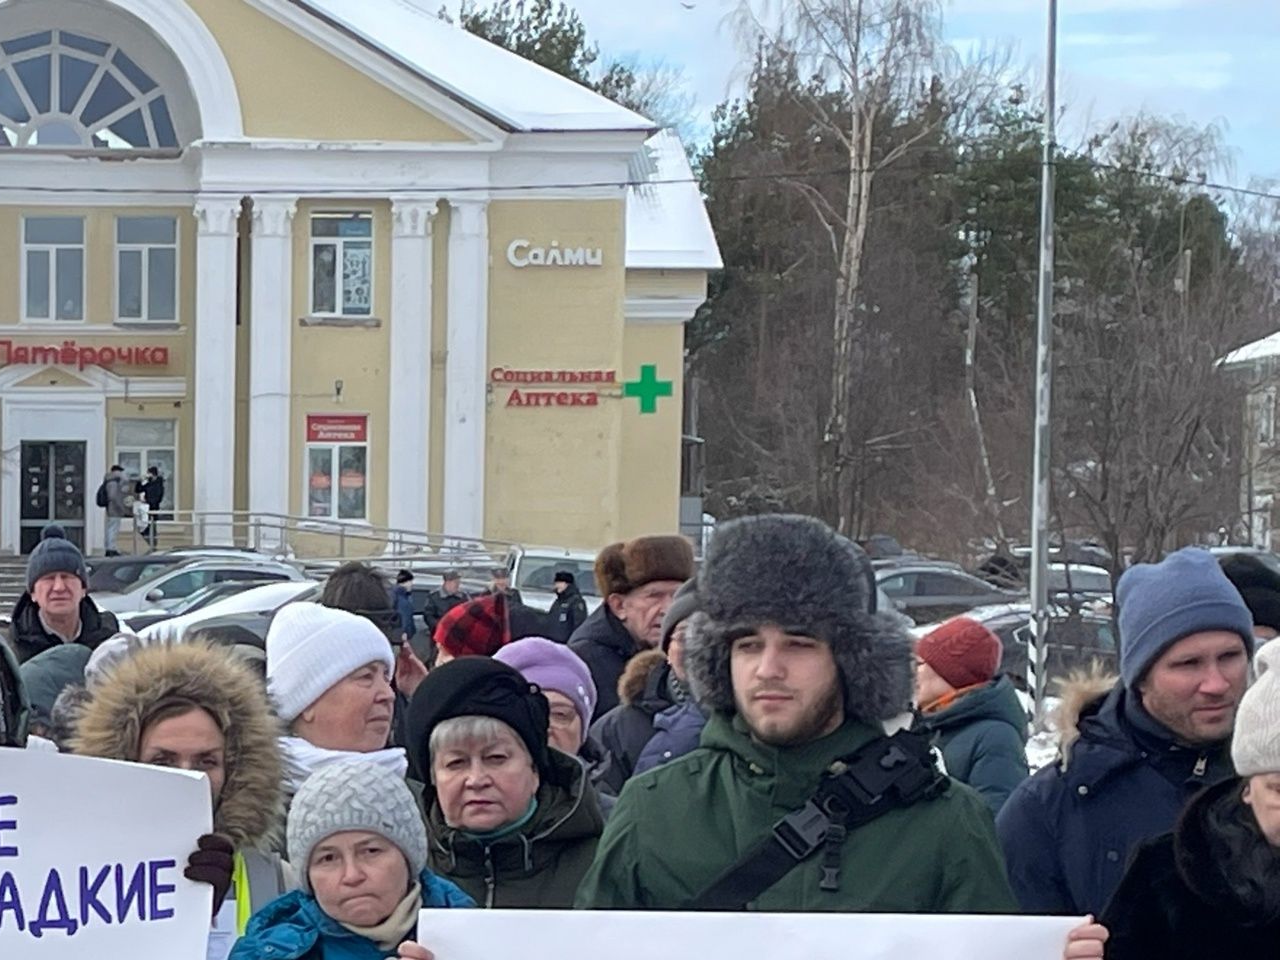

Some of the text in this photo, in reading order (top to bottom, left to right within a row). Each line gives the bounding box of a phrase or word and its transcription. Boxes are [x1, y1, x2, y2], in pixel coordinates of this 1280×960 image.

[507, 239, 603, 267] Салми
[491, 367, 617, 384] Социальная
[506, 389, 599, 407] Аптека
